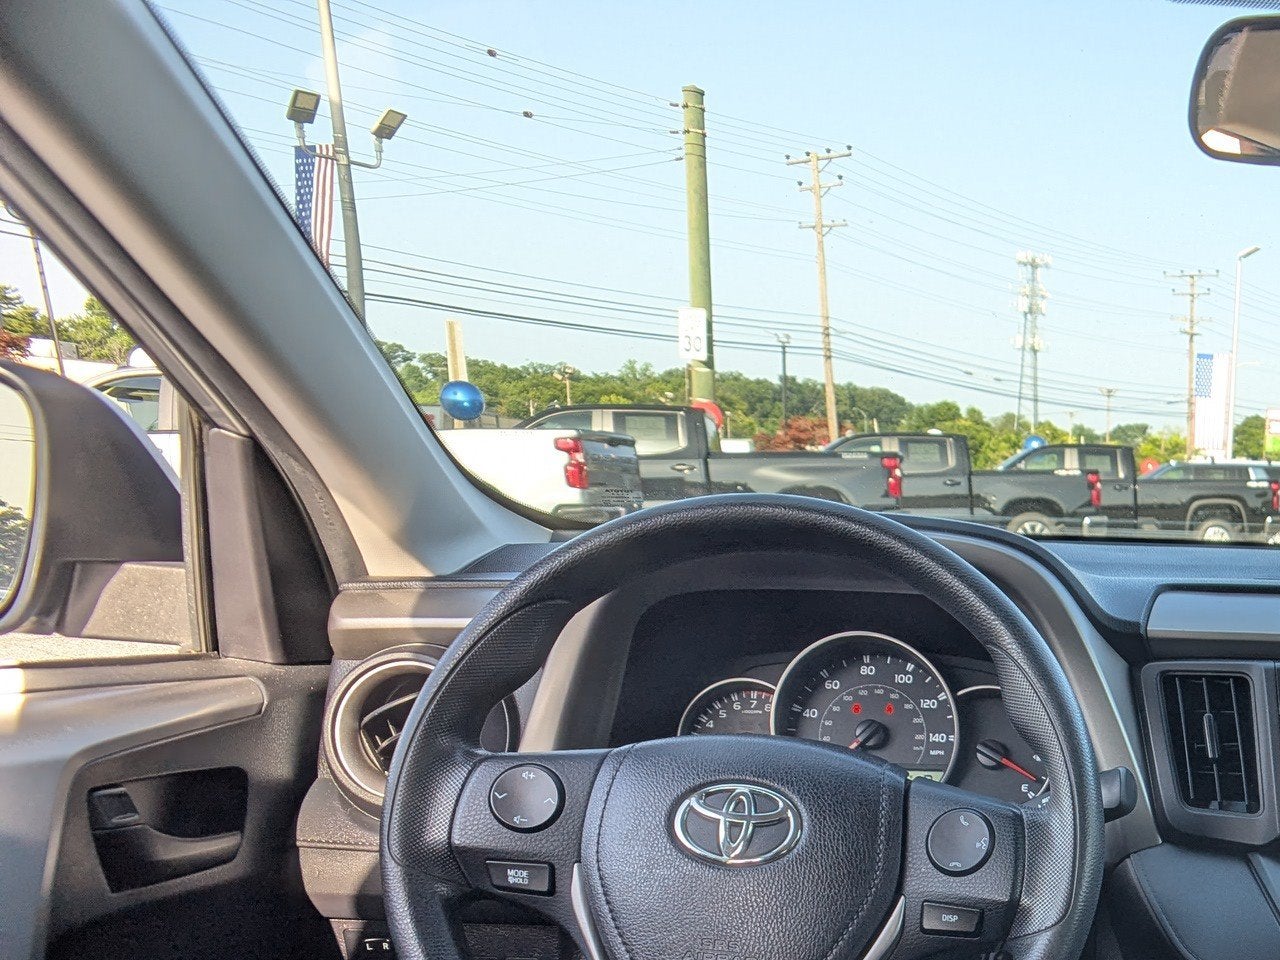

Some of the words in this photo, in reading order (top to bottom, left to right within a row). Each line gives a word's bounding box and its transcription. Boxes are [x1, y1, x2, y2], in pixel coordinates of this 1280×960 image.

[684, 335, 702, 352] 30
[860, 665, 876, 675] 80
[894, 674, 913, 684] 100
[824, 680, 840, 690] 60
[733, 702, 741, 710] 6
[750, 700, 757, 708] 7
[920, 699, 938, 709] 120
[718, 710, 727, 718] 5
[802, 708, 818, 718] 40
[705, 720, 714, 728] 4
[929, 733, 946, 743] 140
[1021, 783, 1029, 793] E
[507, 869, 529, 878] MODE
[941, 914, 959, 923] DISP
[366, 943, 374, 951] L
[382, 942, 390, 950] R
